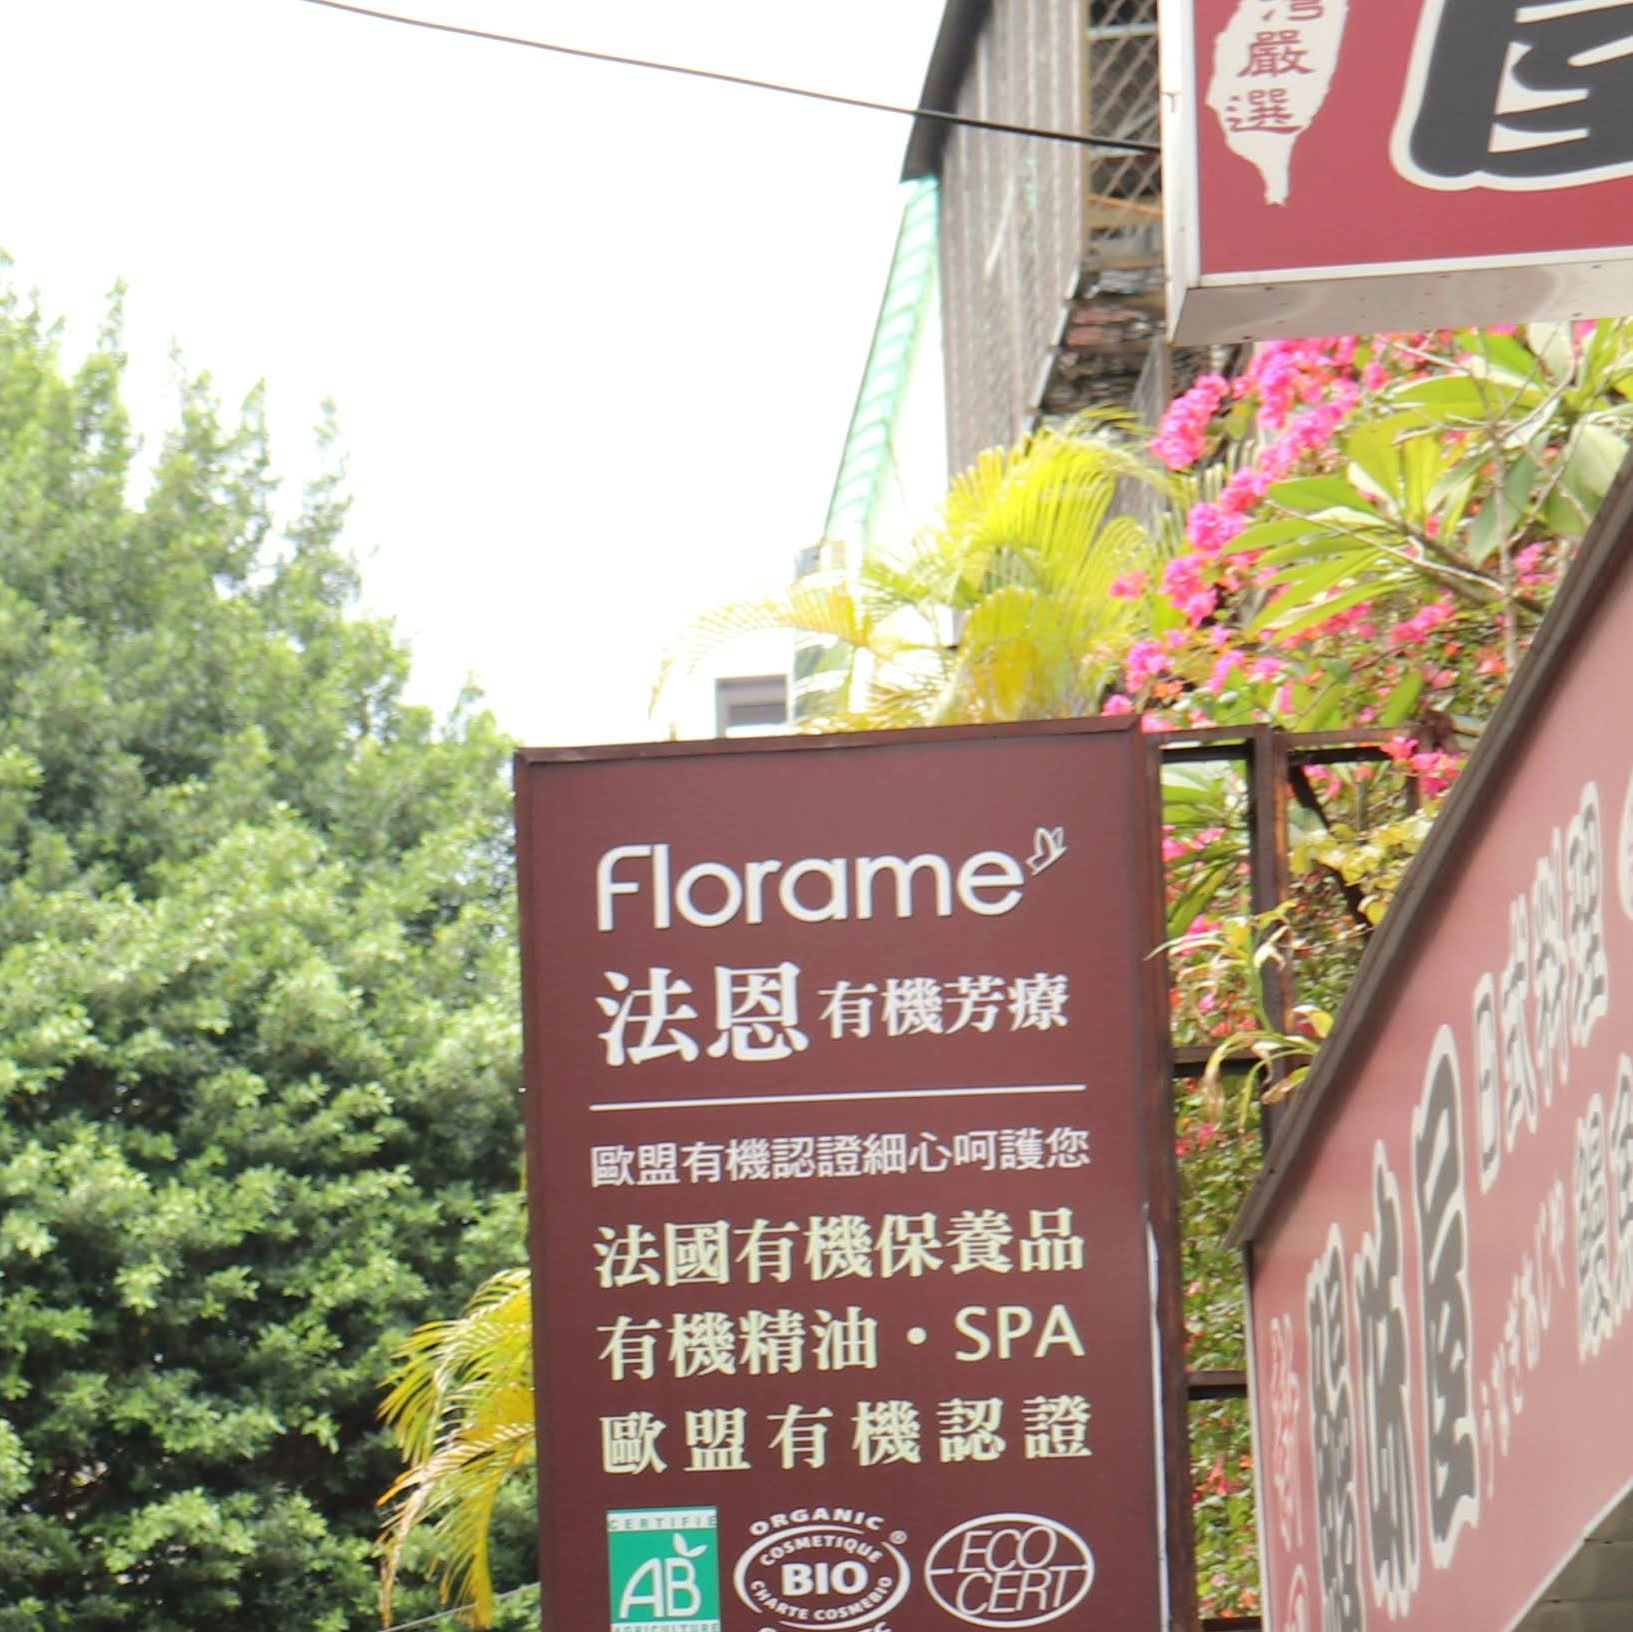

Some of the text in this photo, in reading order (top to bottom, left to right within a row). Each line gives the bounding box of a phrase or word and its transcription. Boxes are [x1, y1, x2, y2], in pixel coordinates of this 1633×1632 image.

[1223, 0, 1326, 134] 嚴選
[596, 843, 1025, 932] Florame
[595, 961, 1070, 1067] 法恩 有機芳療
[1474, 780, 1609, 1194] 日式料理
[590, 1127, 1090, 1188] 歐盟有機認證細心呵護您
[593, 1206, 1084, 1288] 法國有機保養品
[599, 1395, 1092, 1475] 歐盟有機認證
[749, 1506, 884, 1537] ORGANIC
[759, 1535, 884, 1567] COSMETIQUE
[959, 1526, 1057, 1572] ECO
[620, 1556, 702, 1619] AB
[781, 1561, 868, 1597] BIO
[956, 1565, 1075, 1616] CERT
